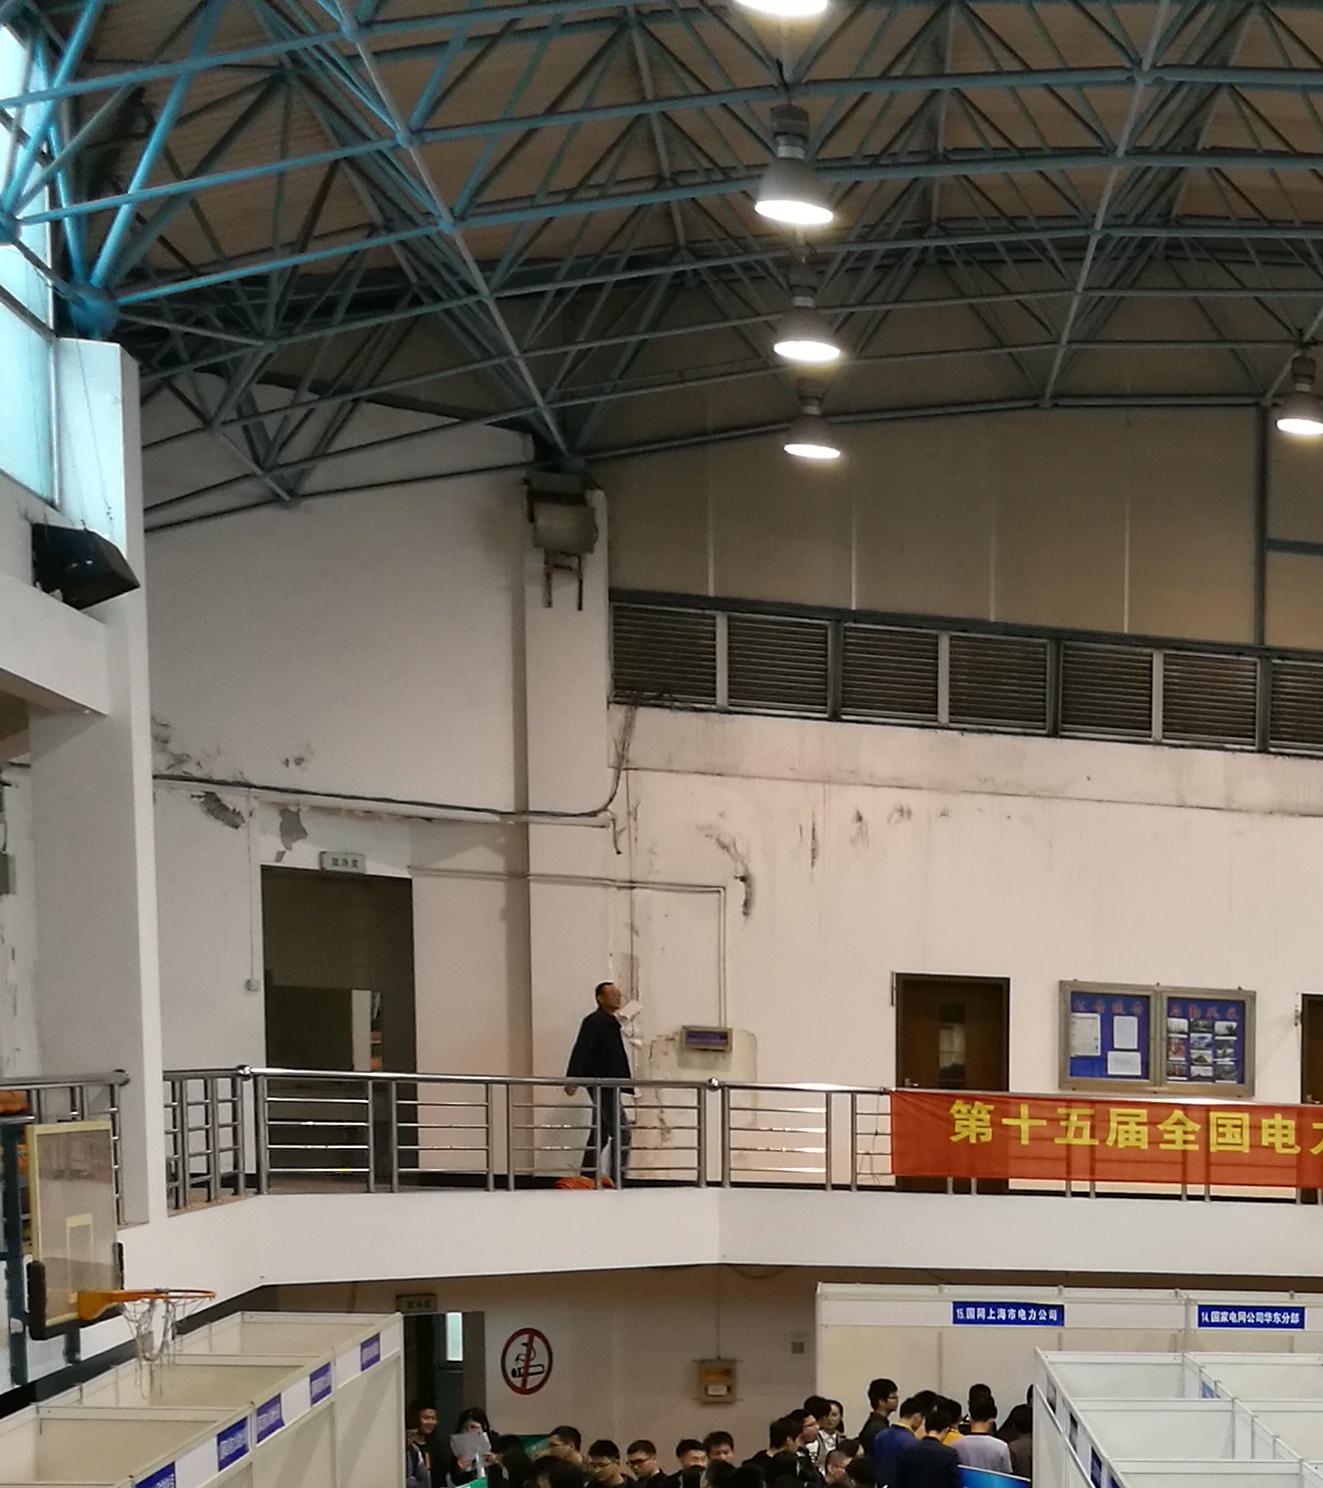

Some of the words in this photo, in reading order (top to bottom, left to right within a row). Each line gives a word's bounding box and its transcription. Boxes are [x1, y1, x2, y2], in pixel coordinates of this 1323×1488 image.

[957, 1308, 1057, 1321] 15.国网上海市电力公司
[1202, 1310, 1300, 1324] 14.国家电网公司华东分部
